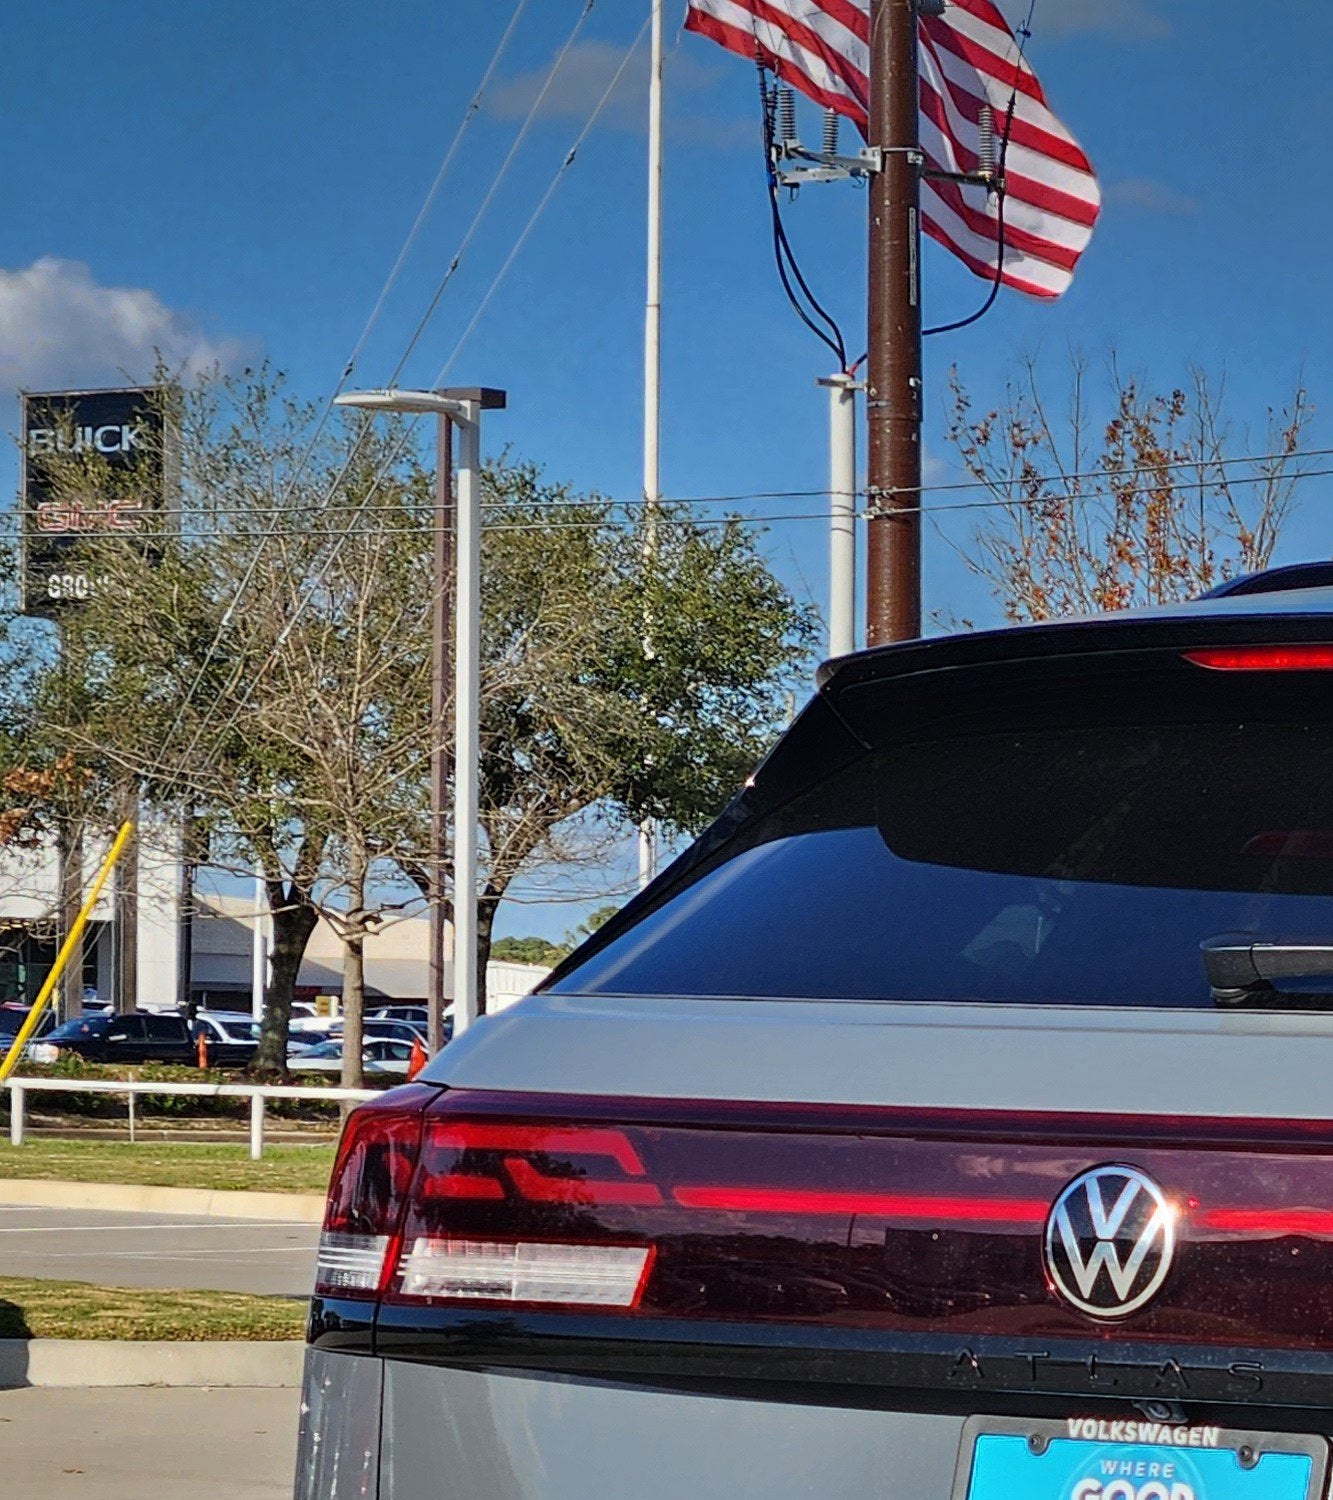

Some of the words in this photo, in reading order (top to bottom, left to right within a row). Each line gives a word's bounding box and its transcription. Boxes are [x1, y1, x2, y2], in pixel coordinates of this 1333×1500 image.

[29, 424, 142, 453] BUICK
[1054, 1175, 1169, 1301] VW
[947, 1347, 1265, 1394] ATLAS
[1067, 1417, 1221, 1448] VOLKSWAGEN
[1100, 1459, 1176, 1479] WHERE
